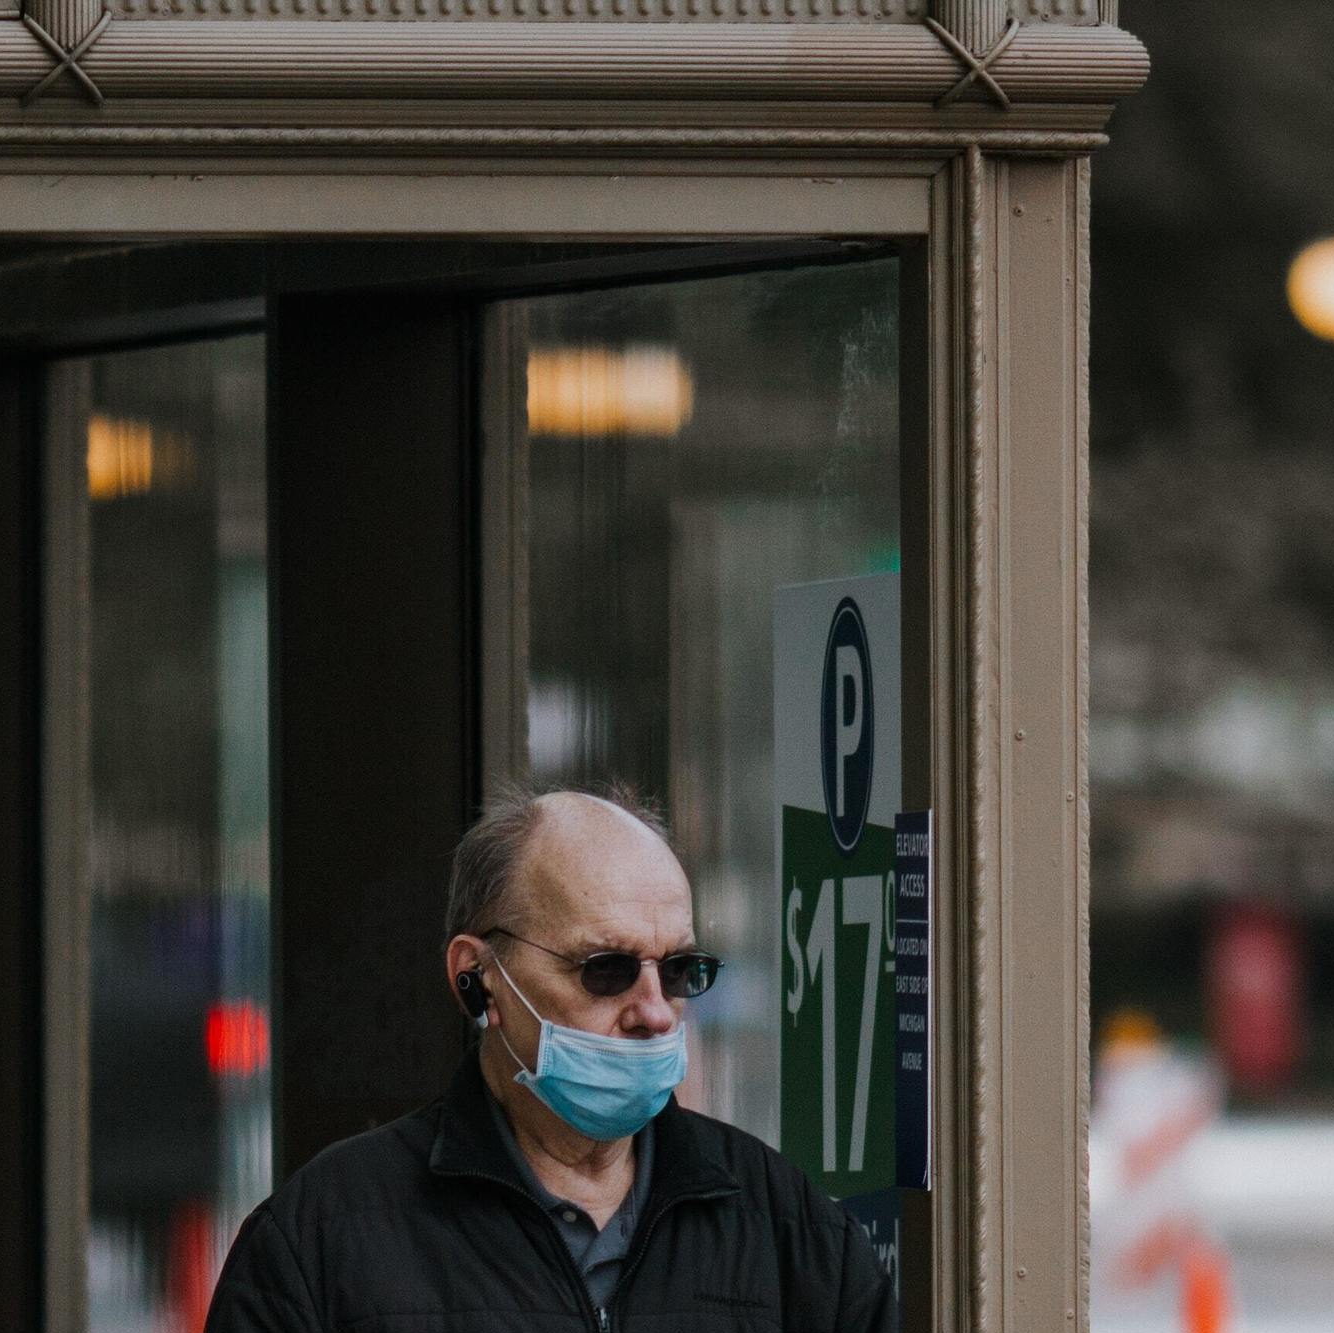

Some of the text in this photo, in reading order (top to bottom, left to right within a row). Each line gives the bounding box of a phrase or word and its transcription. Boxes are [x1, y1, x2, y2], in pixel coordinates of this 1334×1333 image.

[835, 644, 864, 818] P
[899, 873, 925, 898] ACCESS
[896, 937, 919, 956] LOCATED
[895, 975, 908, 994] EAST
[909, 976, 921, 994] SIDE
[898, 1013, 925, 1033] MICHIGAN
[901, 1052, 922, 1071] AVENUE
